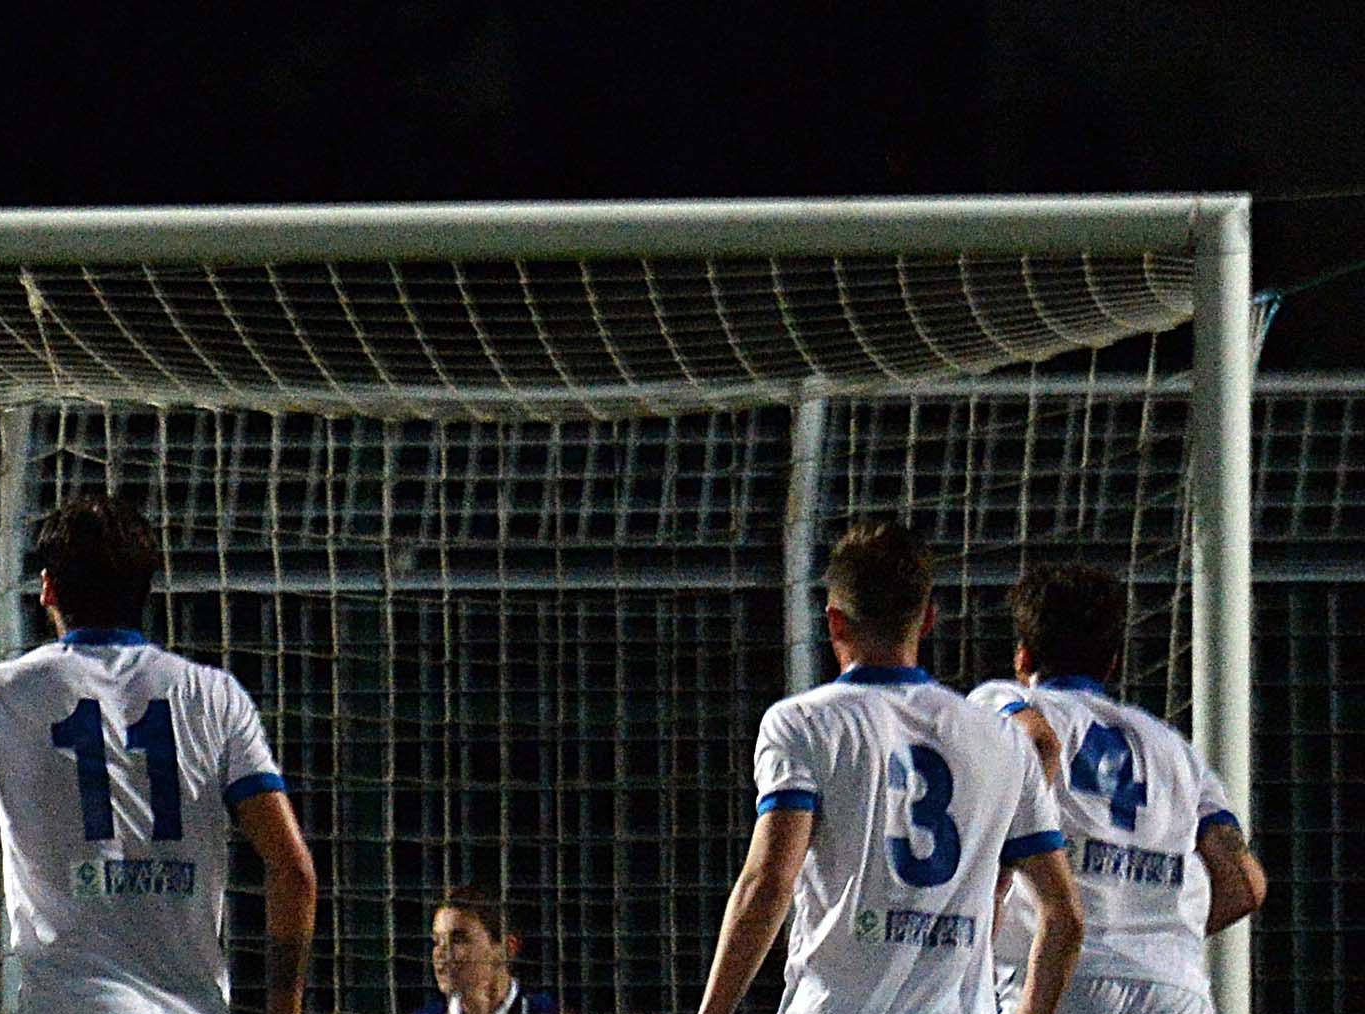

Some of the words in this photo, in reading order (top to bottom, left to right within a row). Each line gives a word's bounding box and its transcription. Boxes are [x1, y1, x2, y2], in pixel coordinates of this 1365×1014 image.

[52, 698, 182, 840] 11
[886, 744, 961, 888] 3
[1071, 721, 1146, 832] 4
